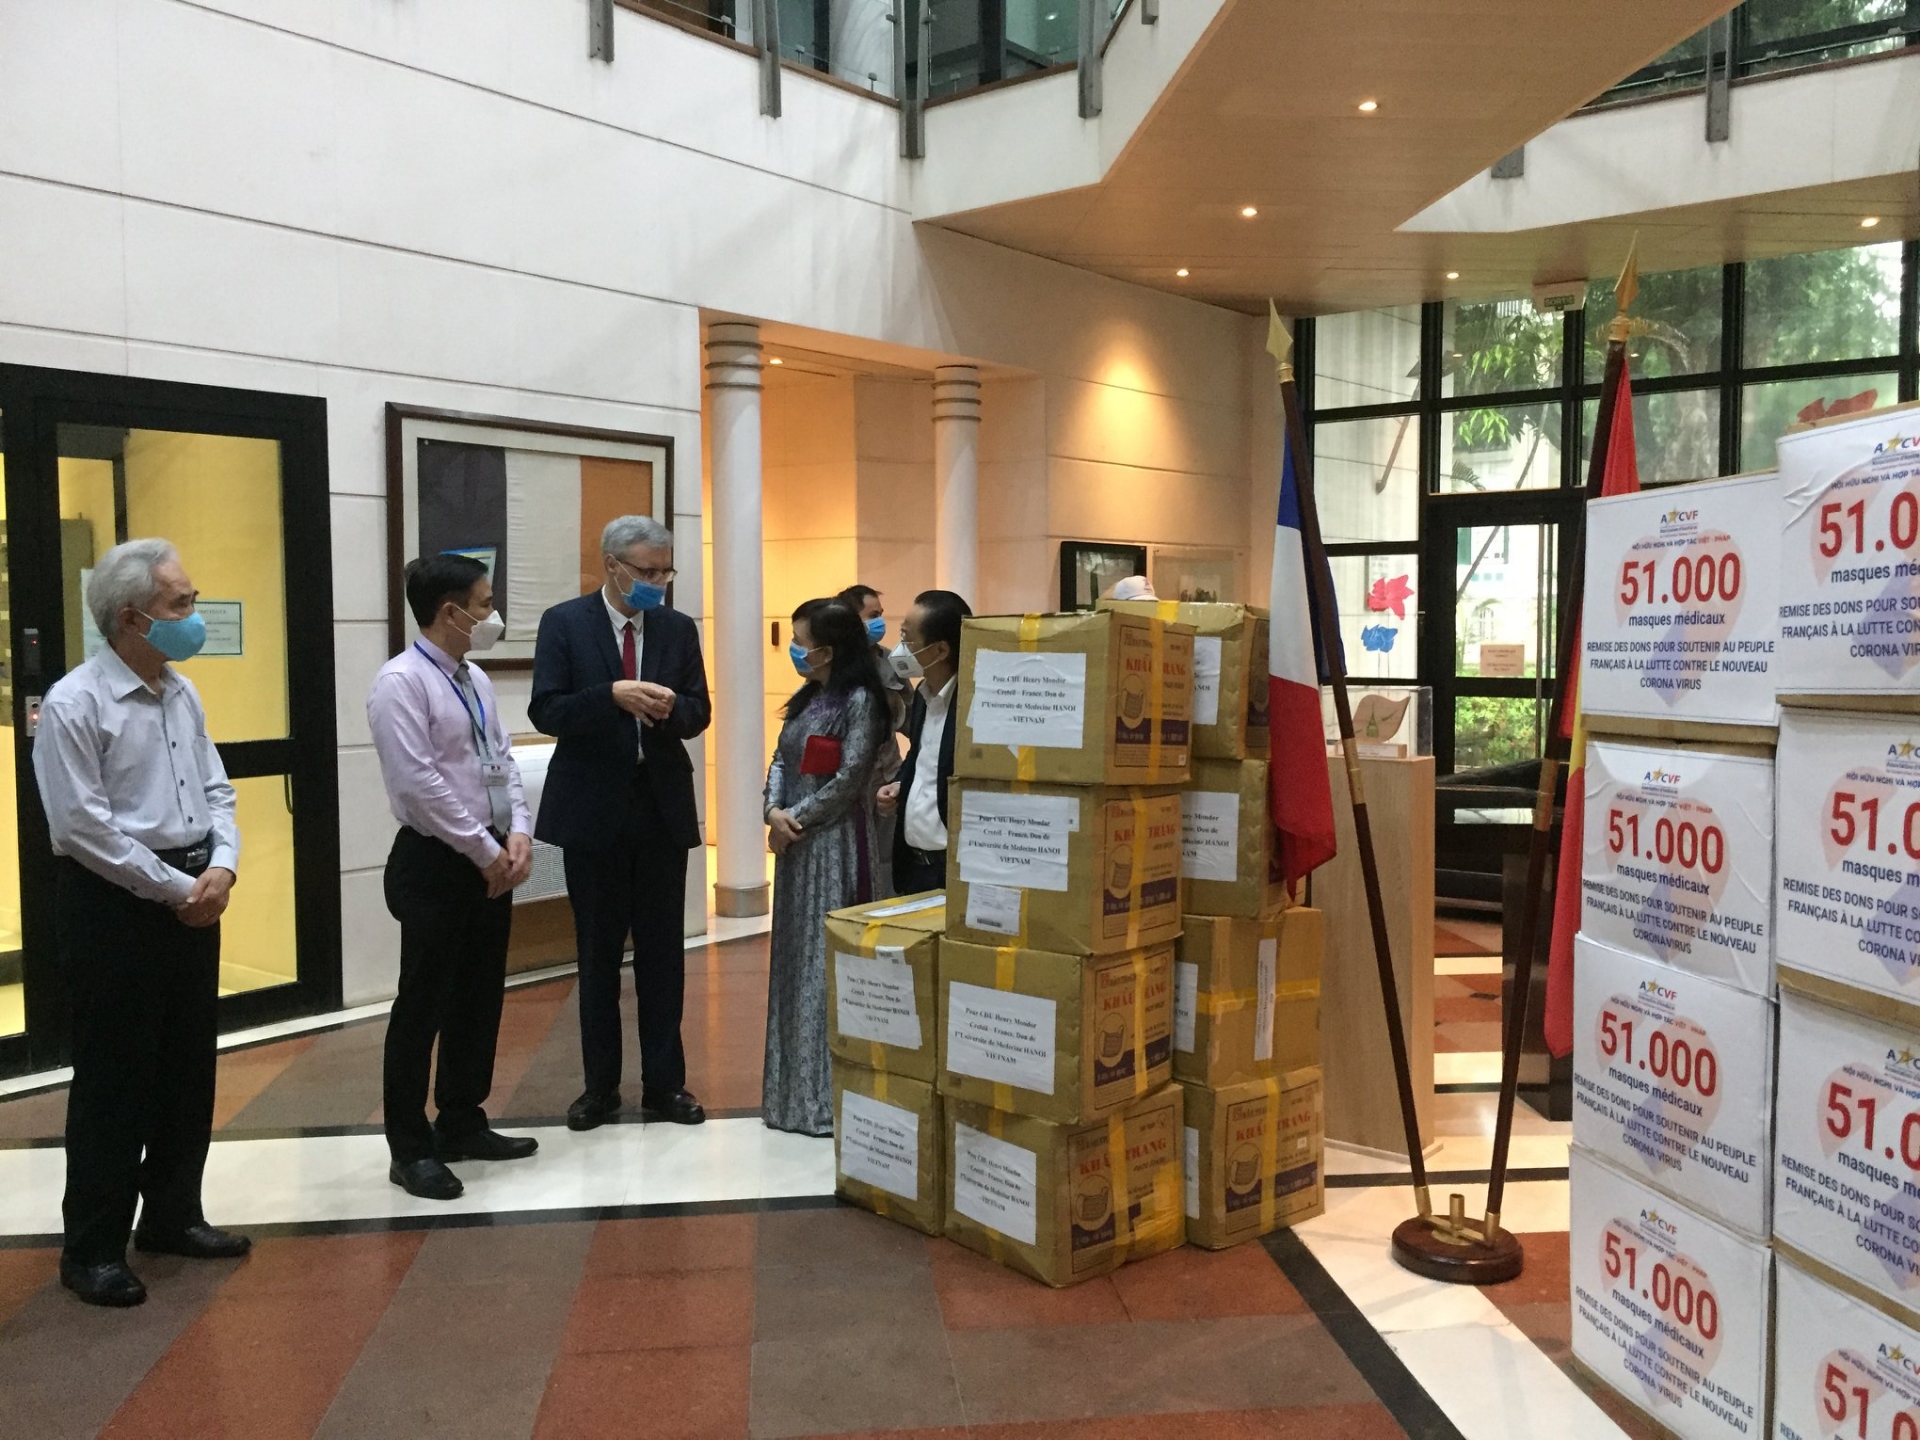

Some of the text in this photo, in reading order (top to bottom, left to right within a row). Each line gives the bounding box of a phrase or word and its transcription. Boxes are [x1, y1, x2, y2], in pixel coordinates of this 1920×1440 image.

[1621, 553, 1740, 604] 51.000
[1830, 565, 1890, 587] masques
[1628, 609, 1725, 629] masques médicaux
[1813, 603, 1830, 616] DES
[1833, 600, 1862, 614] DONS
[1866, 598, 1896, 613] POUR
[1587, 640, 1774, 652] REMISE DES DONS POUR SOUTENIR AU PEUPLE
[1781, 624, 1829, 641] FRANÇAIS
[1830, 620, 1838, 636] À
[1841, 623, 1854, 635] LA
[1857, 620, 1892, 635] LUTTE
[1850, 643, 1898, 657] CORONA
[1590, 656, 1767, 672] FRANÇAIS À LA LUTTE CONTRE LE NOUVEAU
[1640, 677, 1701, 690] CORONA VIRUS
[1609, 810, 1723, 873] 51.000
[1616, 864, 1709, 895] masques médicaux
[1841, 860, 1902, 887] masques
[1619, 890, 1639, 904] DONS
[1642, 896, 1662, 910] POUR
[1664, 901, 1706, 922] SOUTENIR
[1709, 912, 1721, 925] AU
[1725, 916, 1762, 936] PEUPLE
[1784, 878, 1818, 897] REMISE
[1822, 886, 1841, 902] DES
[1844, 891, 1873, 910] DONS
[1877, 899, 1907, 918] POUR
[1584, 896, 1755, 954] FRANÇAIS À LA LUTTE CONTRE LE NOUVEAU
[1788, 899, 1838, 926] FRANÇAIS
[1840, 908, 1848, 925] À
[1850, 915, 1863, 929] LA
[1867, 918, 1902, 939] LUTTE
[1632, 927, 1691, 954] CORONA VIRUS
[1857, 938, 1905, 963] CORONA
[1601, 1012, 1716, 1096] 51.000
[1608, 1067, 1702, 1117] masques médicaux
[1575, 1091, 1747, 1184] FRANÇAIS À LA LUTTE CONTRE LE NOUVEAU
[1611, 1093, 1630, 1111] DONS
[1633, 1103, 1653, 1122] POUR
[1656, 1114, 1698, 1143] SOUTENIR
[1701, 1134, 1712, 1149] AU
[1717, 1140, 1754, 1168] PEUPLE
[1622, 1132, 1681, 1172] CORONA VIRUS
[1837, 1151, 1899, 1194] masques
[1780, 1154, 1815, 1181] REMISE
[1818, 1173, 1837, 1193] DES
[1840, 1183, 1870, 1209] DONS
[1873, 1199, 1904, 1226] POUR
[1785, 1176, 1835, 1215] FRANÇAIS
[1837, 1199, 1844, 1217] À
[1847, 1207, 1861, 1225] LA
[1863, 1215, 1900, 1246] LUTTE
[1855, 1232, 1904, 1269] CORONA
[1605, 1232, 1717, 1339] 51.000
[1612, 1289, 1703, 1360] masques médicaux
[1577, 1305, 1746, 1435] FRANÇAIS À LA LUTTE CONTRE LE NOUVEAU
[1613, 1315, 1633, 1338] DONS
[1635, 1331, 1655, 1354] POUR
[1658, 1346, 1699, 1385] SOUTENIR
[1702, 1375, 1713, 1393] AU
[1717, 1384, 1753, 1420] PEUPLE
[1623, 1356, 1682, 1409] CORONA VIRUS
